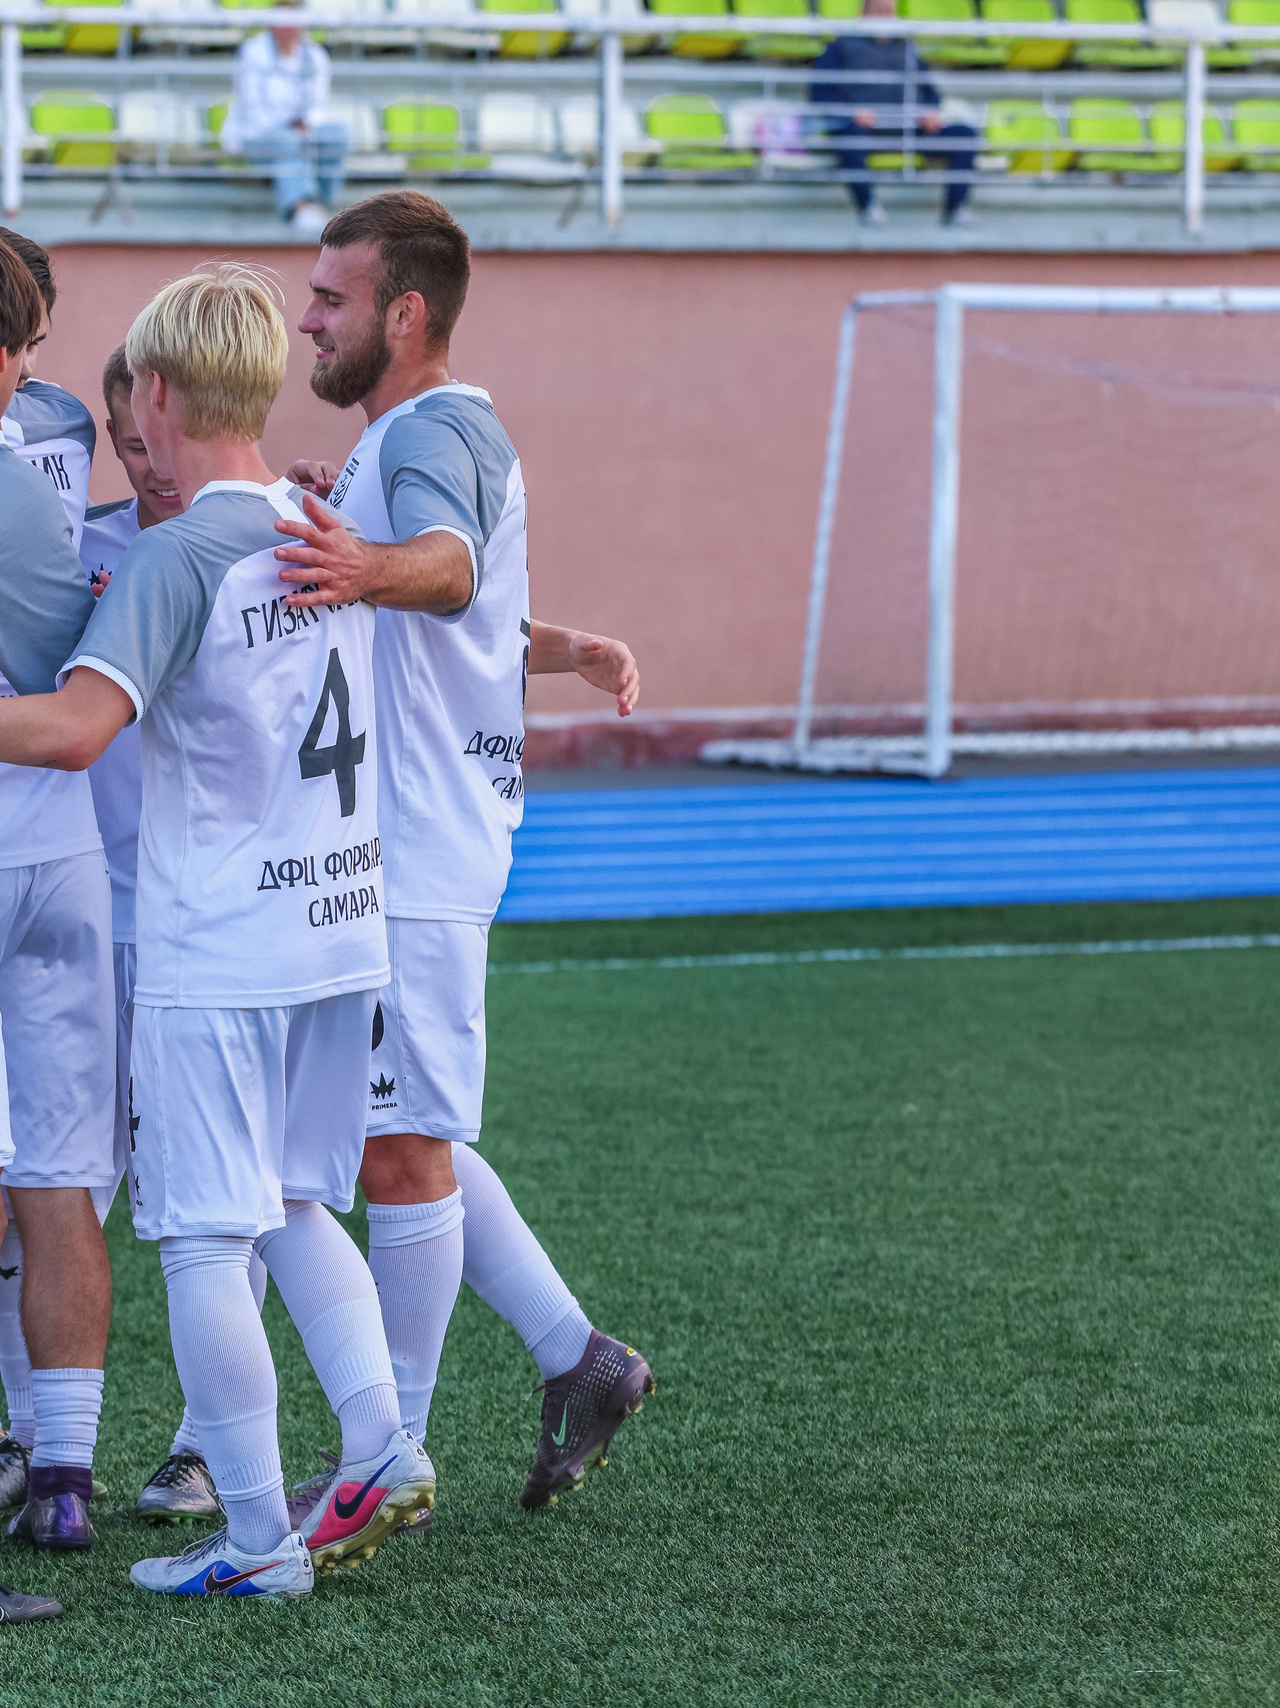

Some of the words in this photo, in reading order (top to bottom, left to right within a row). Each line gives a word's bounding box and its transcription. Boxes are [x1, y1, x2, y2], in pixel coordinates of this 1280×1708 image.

[298, 647, 367, 818] 4
[463, 730, 518, 764] ДФЦ
[257, 855, 320, 891] ДФЦ
[324, 837, 383, 881] ФОРВАР
[308, 885, 380, 928] САМАРА
[371, 1102, 398, 1111] PRIMERA
